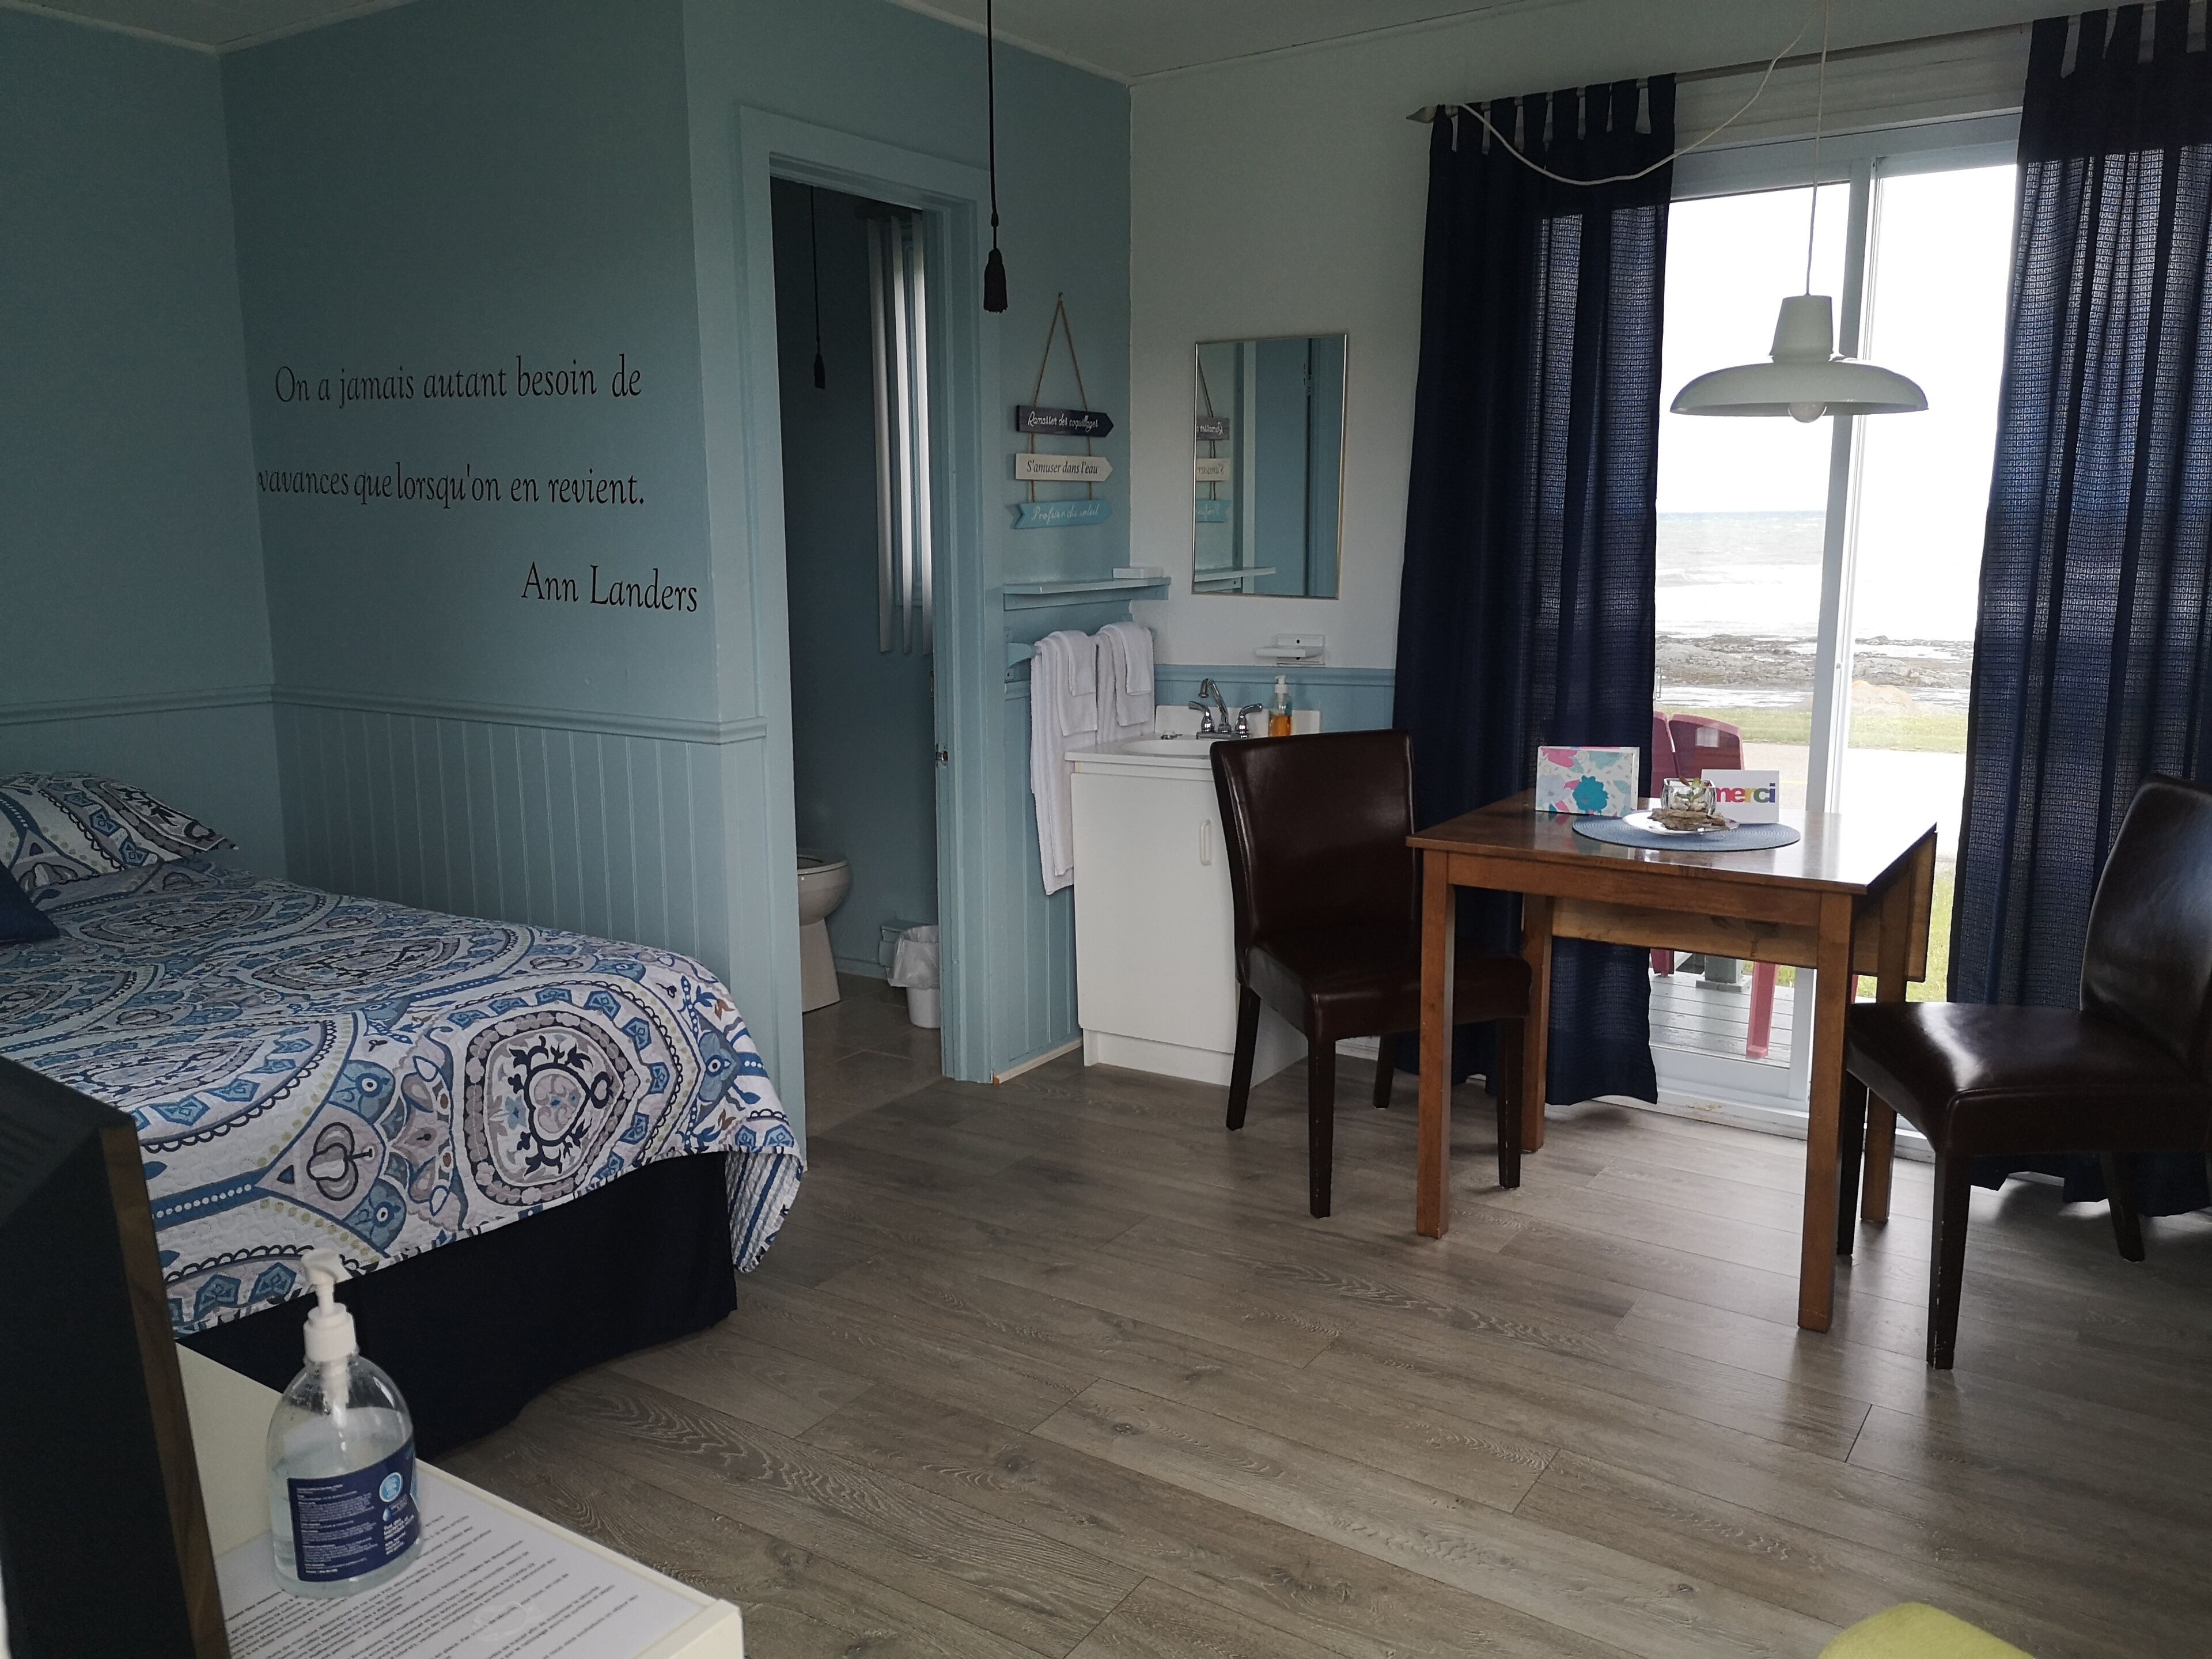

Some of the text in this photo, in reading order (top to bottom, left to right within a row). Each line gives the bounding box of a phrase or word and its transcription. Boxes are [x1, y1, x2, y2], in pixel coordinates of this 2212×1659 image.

[275, 353, 642, 410] On a jamais autant besoin de
[1027, 411, 1058, 427] Ramasser
[1058, 413, 1068, 426] des
[1027, 460, 1098, 474] S'amuser dans l'eau
[510, 478, 540, 503] en
[548, 468, 645, 506] revient.
[521, 561, 698, 613] Ann Landers
[1715, 782, 1776, 803] merci
